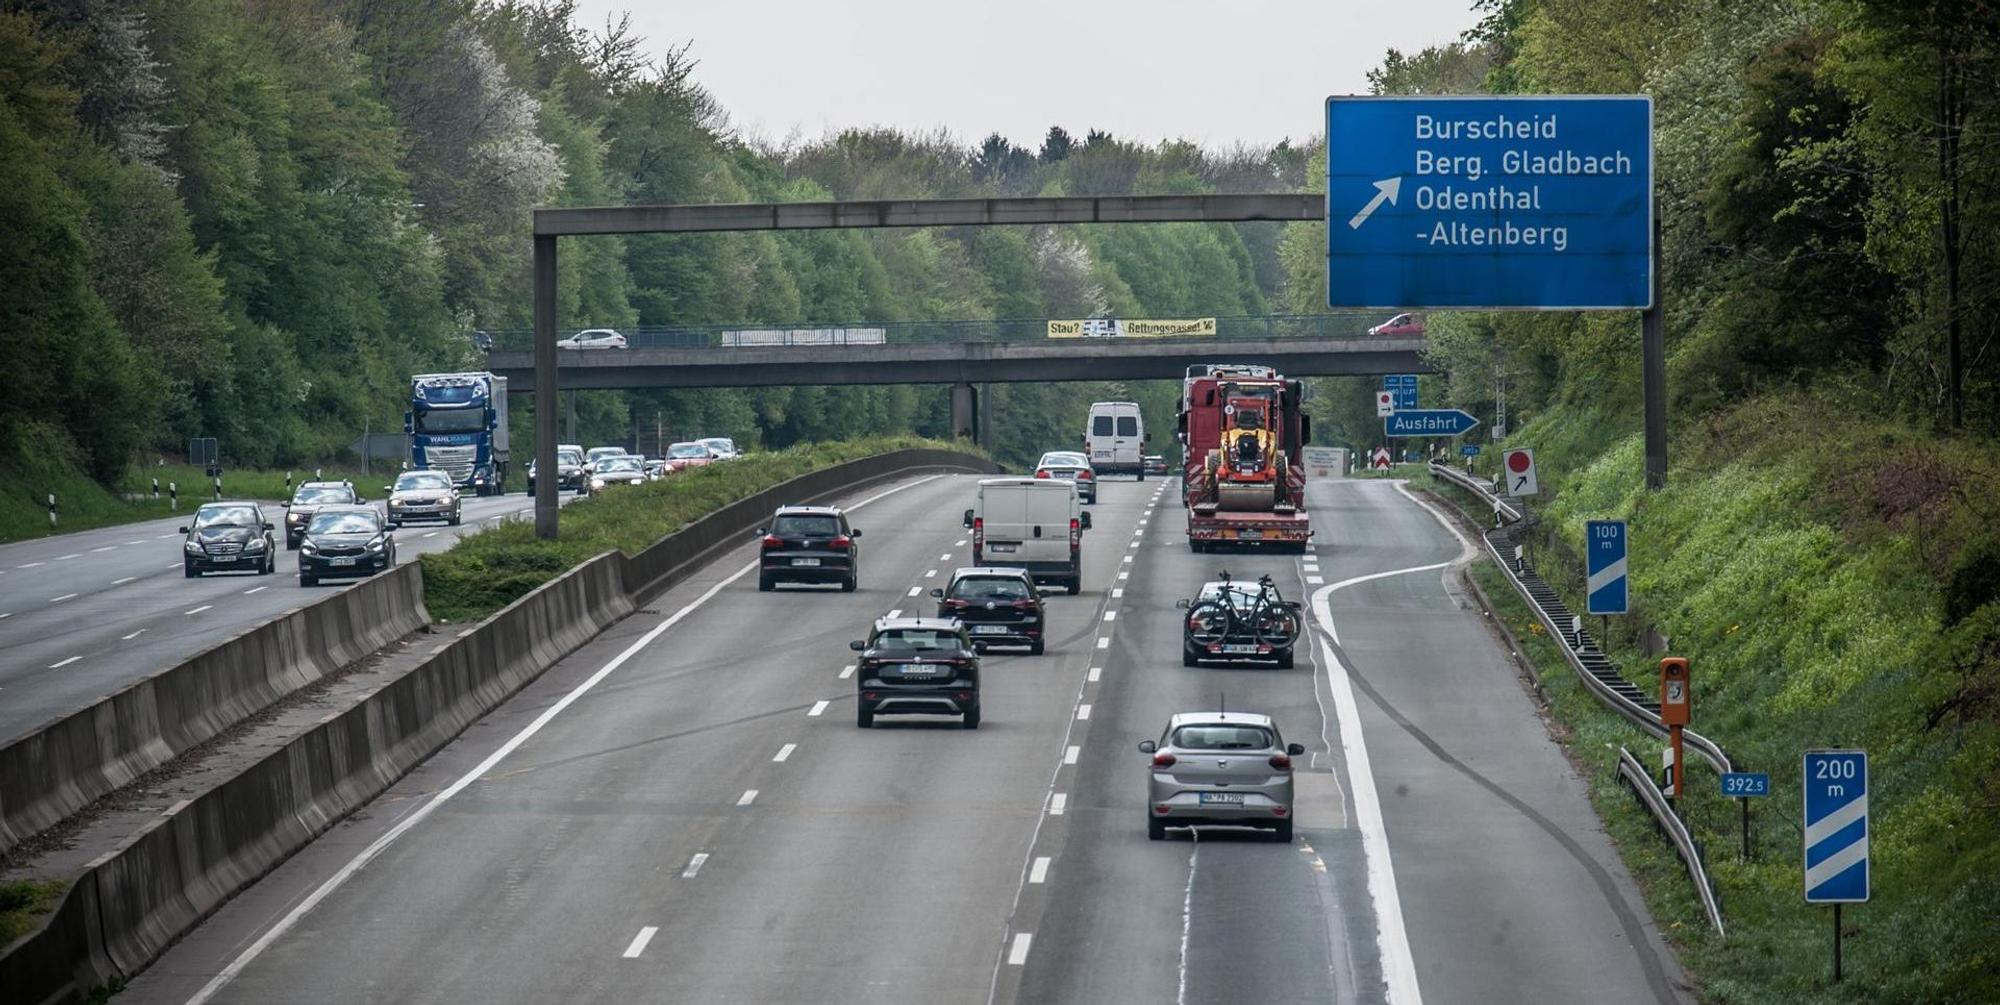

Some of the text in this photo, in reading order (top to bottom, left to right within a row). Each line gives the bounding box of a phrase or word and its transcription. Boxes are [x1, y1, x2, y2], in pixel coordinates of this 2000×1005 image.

[1416, 114, 1557, 139] Burscheid
[1416, 150, 1631, 180] Berg. Gladbach
[1416, 186, 1541, 210] Odenthal
[1416, 221, 1567, 251] -Altenberg
[1050, 322, 1080, 334] Stau?
[1394, 415, 1458, 430] Ausfahrt
[1595, 525, 1618, 539] 100
[1601, 541, 1612, 549] m
[1816, 759, 1855, 779] 200
[1727, 777, 1764, 791] 392.5
[1827, 784, 1844, 798] m
